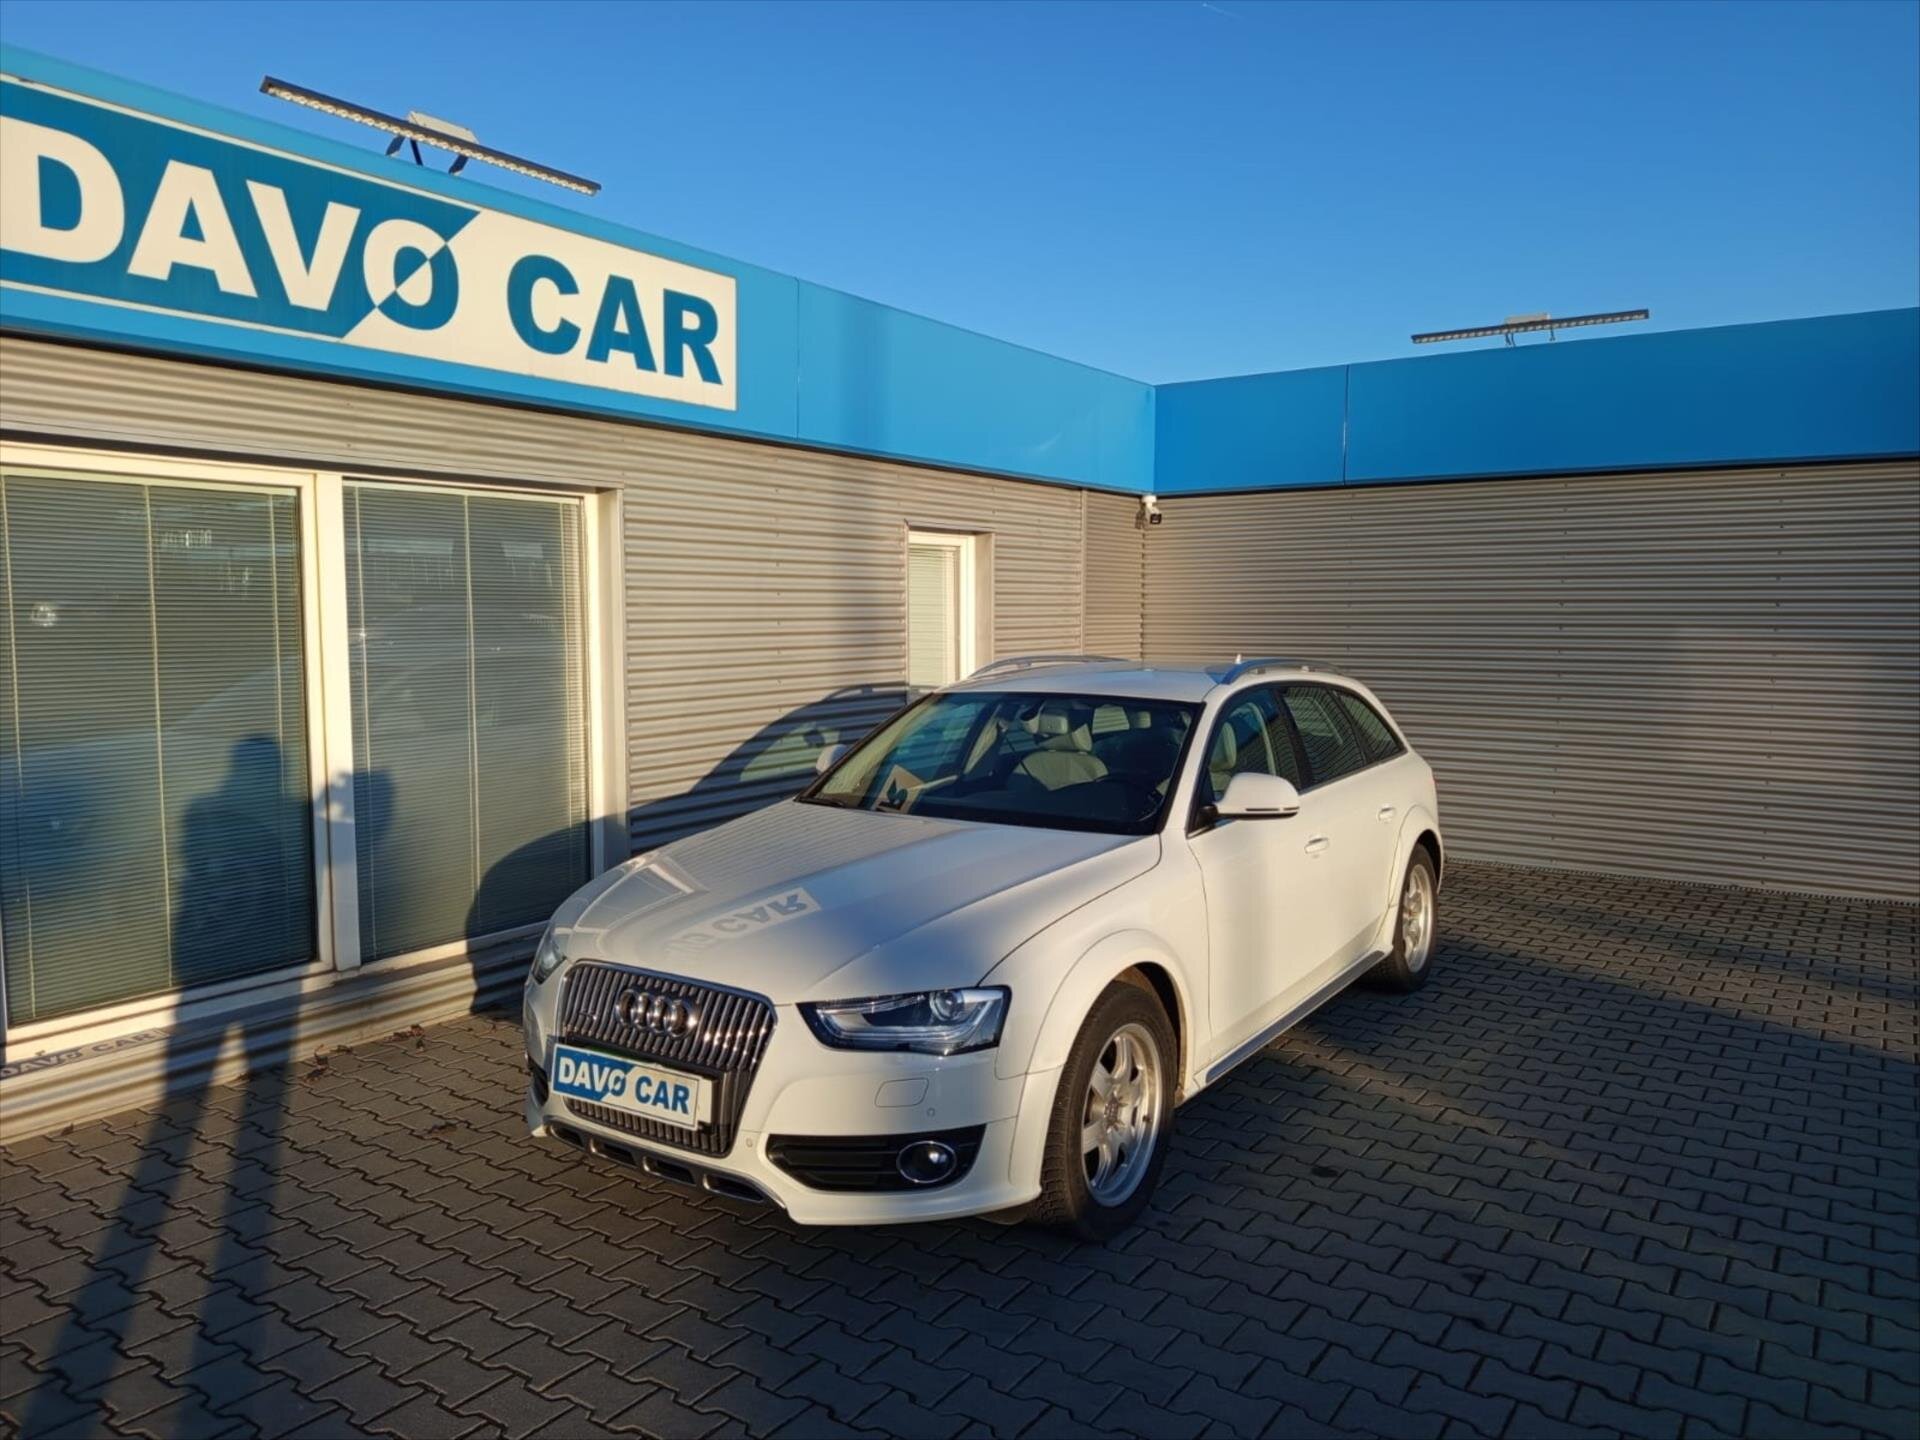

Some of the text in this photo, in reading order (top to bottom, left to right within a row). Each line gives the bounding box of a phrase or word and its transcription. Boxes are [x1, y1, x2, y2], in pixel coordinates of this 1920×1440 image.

[506, 254, 723, 385] CAR
[92, 1033, 154, 1052] CAR
[635, 1075, 690, 1115] CAR
